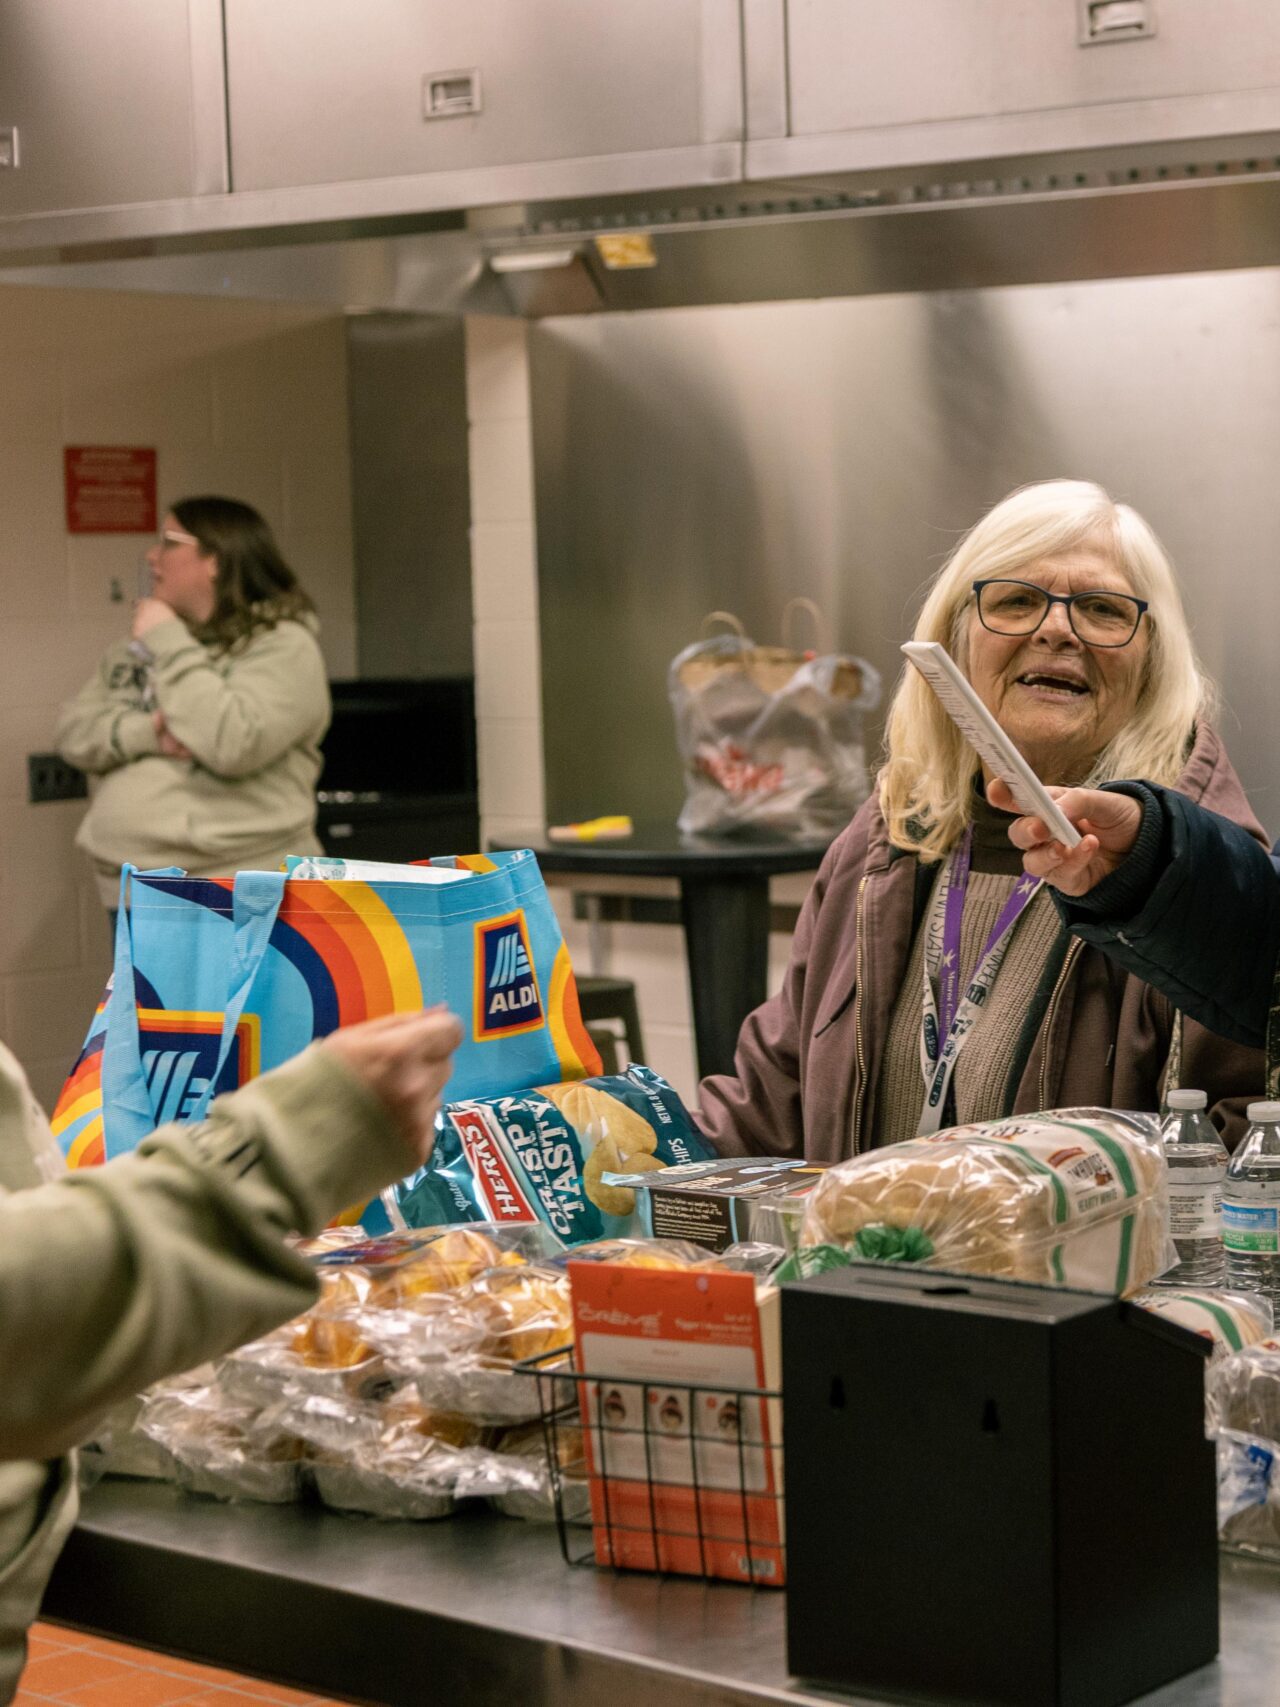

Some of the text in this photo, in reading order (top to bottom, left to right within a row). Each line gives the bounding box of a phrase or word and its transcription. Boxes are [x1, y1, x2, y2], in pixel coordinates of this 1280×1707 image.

[489, 983, 538, 1015] ALDI
[657, 1112, 673, 1124] NET
[461, 1123, 522, 1217] HERR'S
[507, 1124, 572, 1235] CRISP
[521, 1098, 585, 1220] TASTY
[668, 1138, 692, 1166] HIPS
